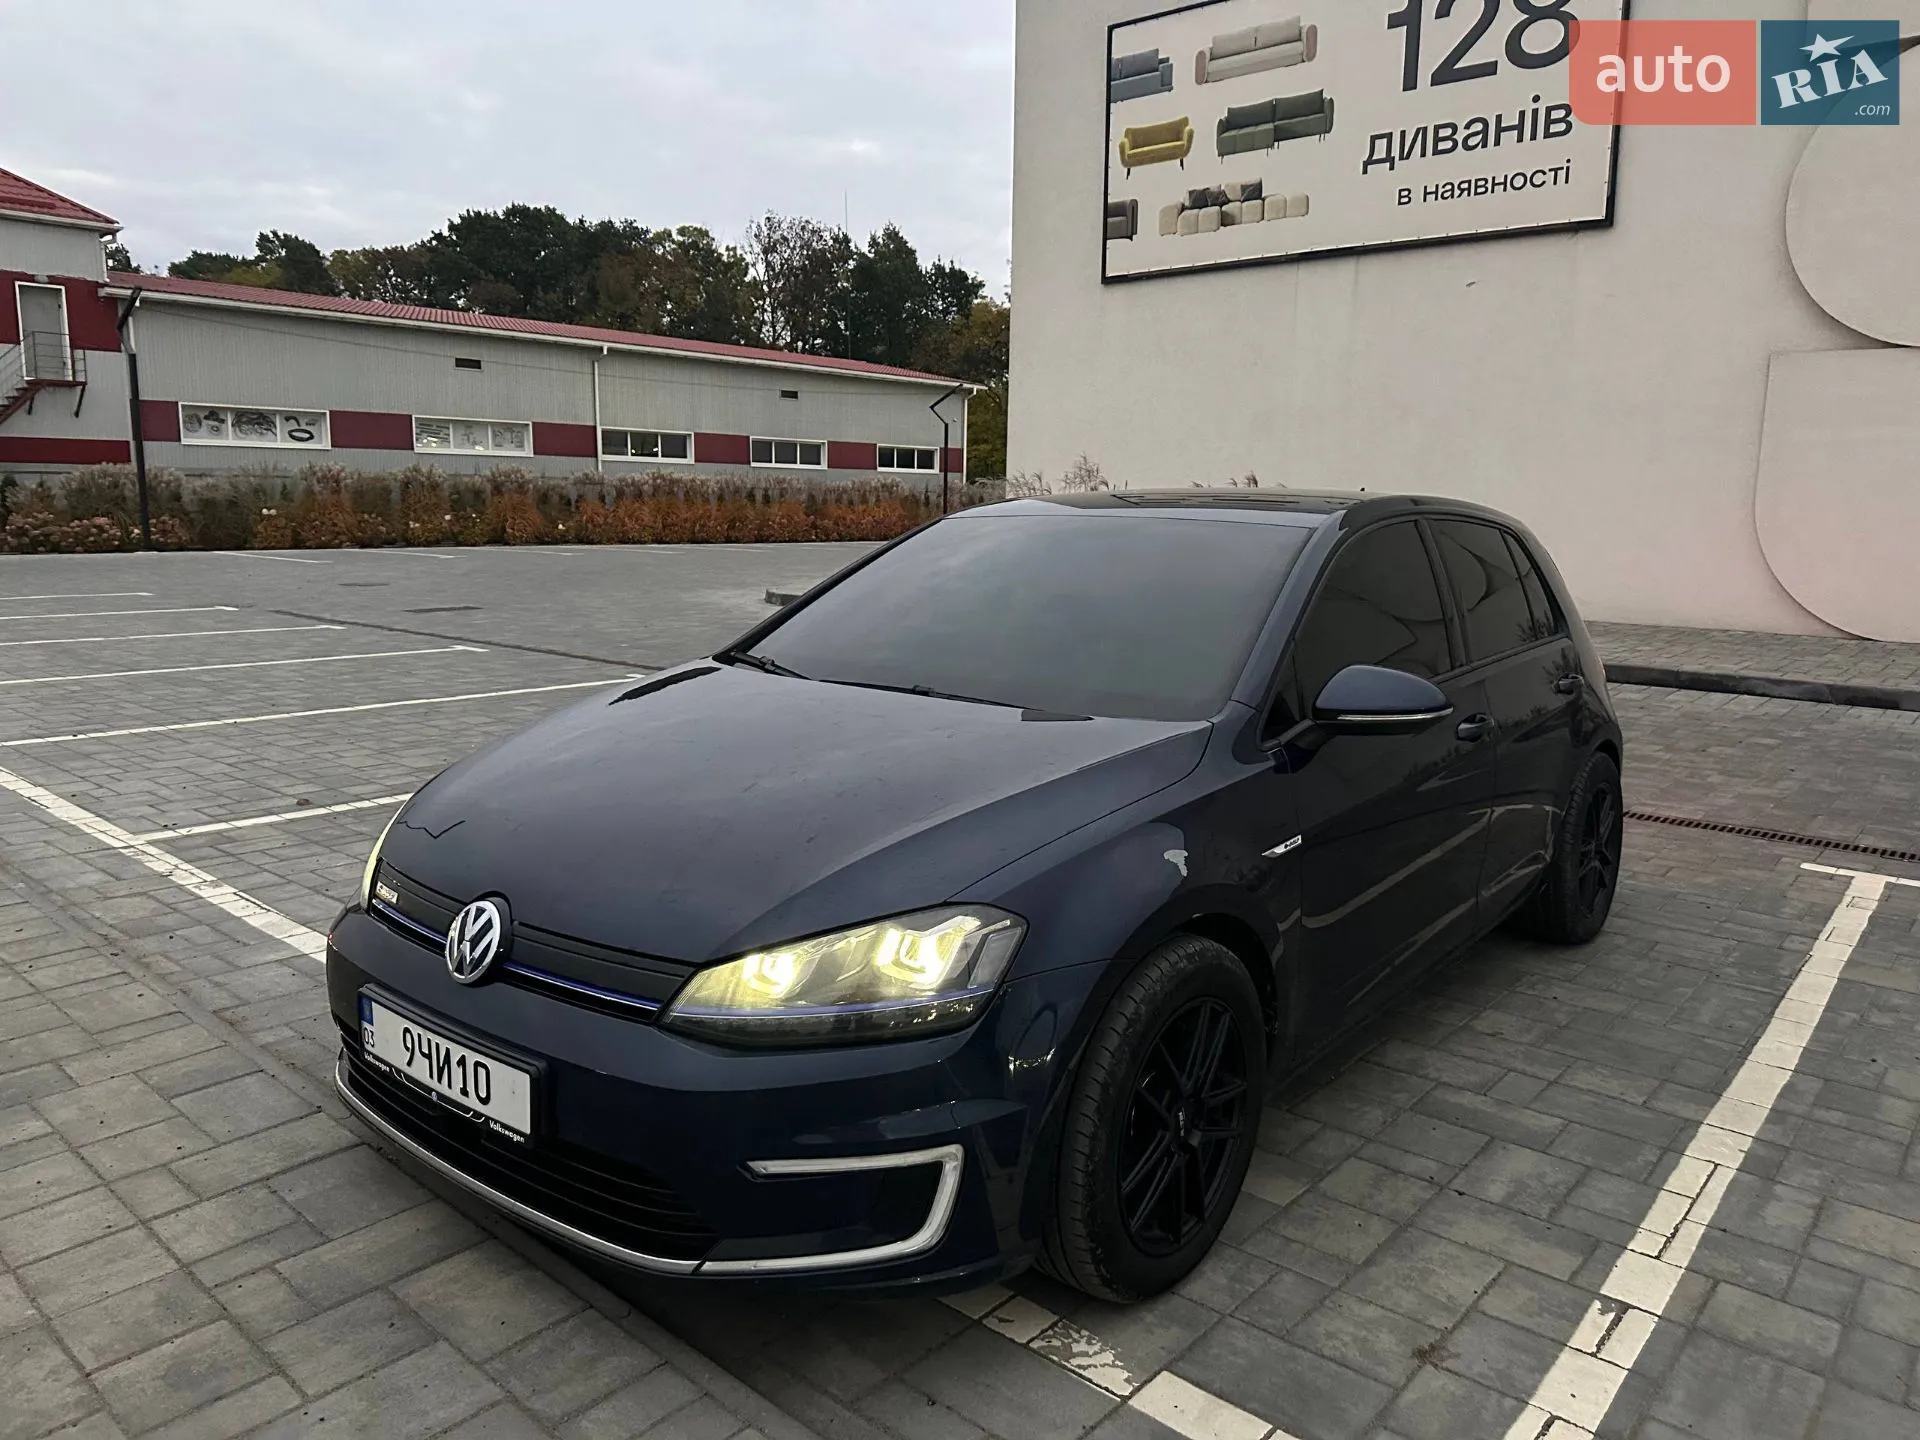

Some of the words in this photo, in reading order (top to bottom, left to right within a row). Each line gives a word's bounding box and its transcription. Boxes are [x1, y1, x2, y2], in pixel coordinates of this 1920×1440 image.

[1387, 0, 1581, 92] 128
[1361, 94, 1573, 175] диванів
[1397, 187, 1412, 206] в
[1422, 158, 1572, 203] наявності
[489, 1119, 525, 1144] Volkswagen
